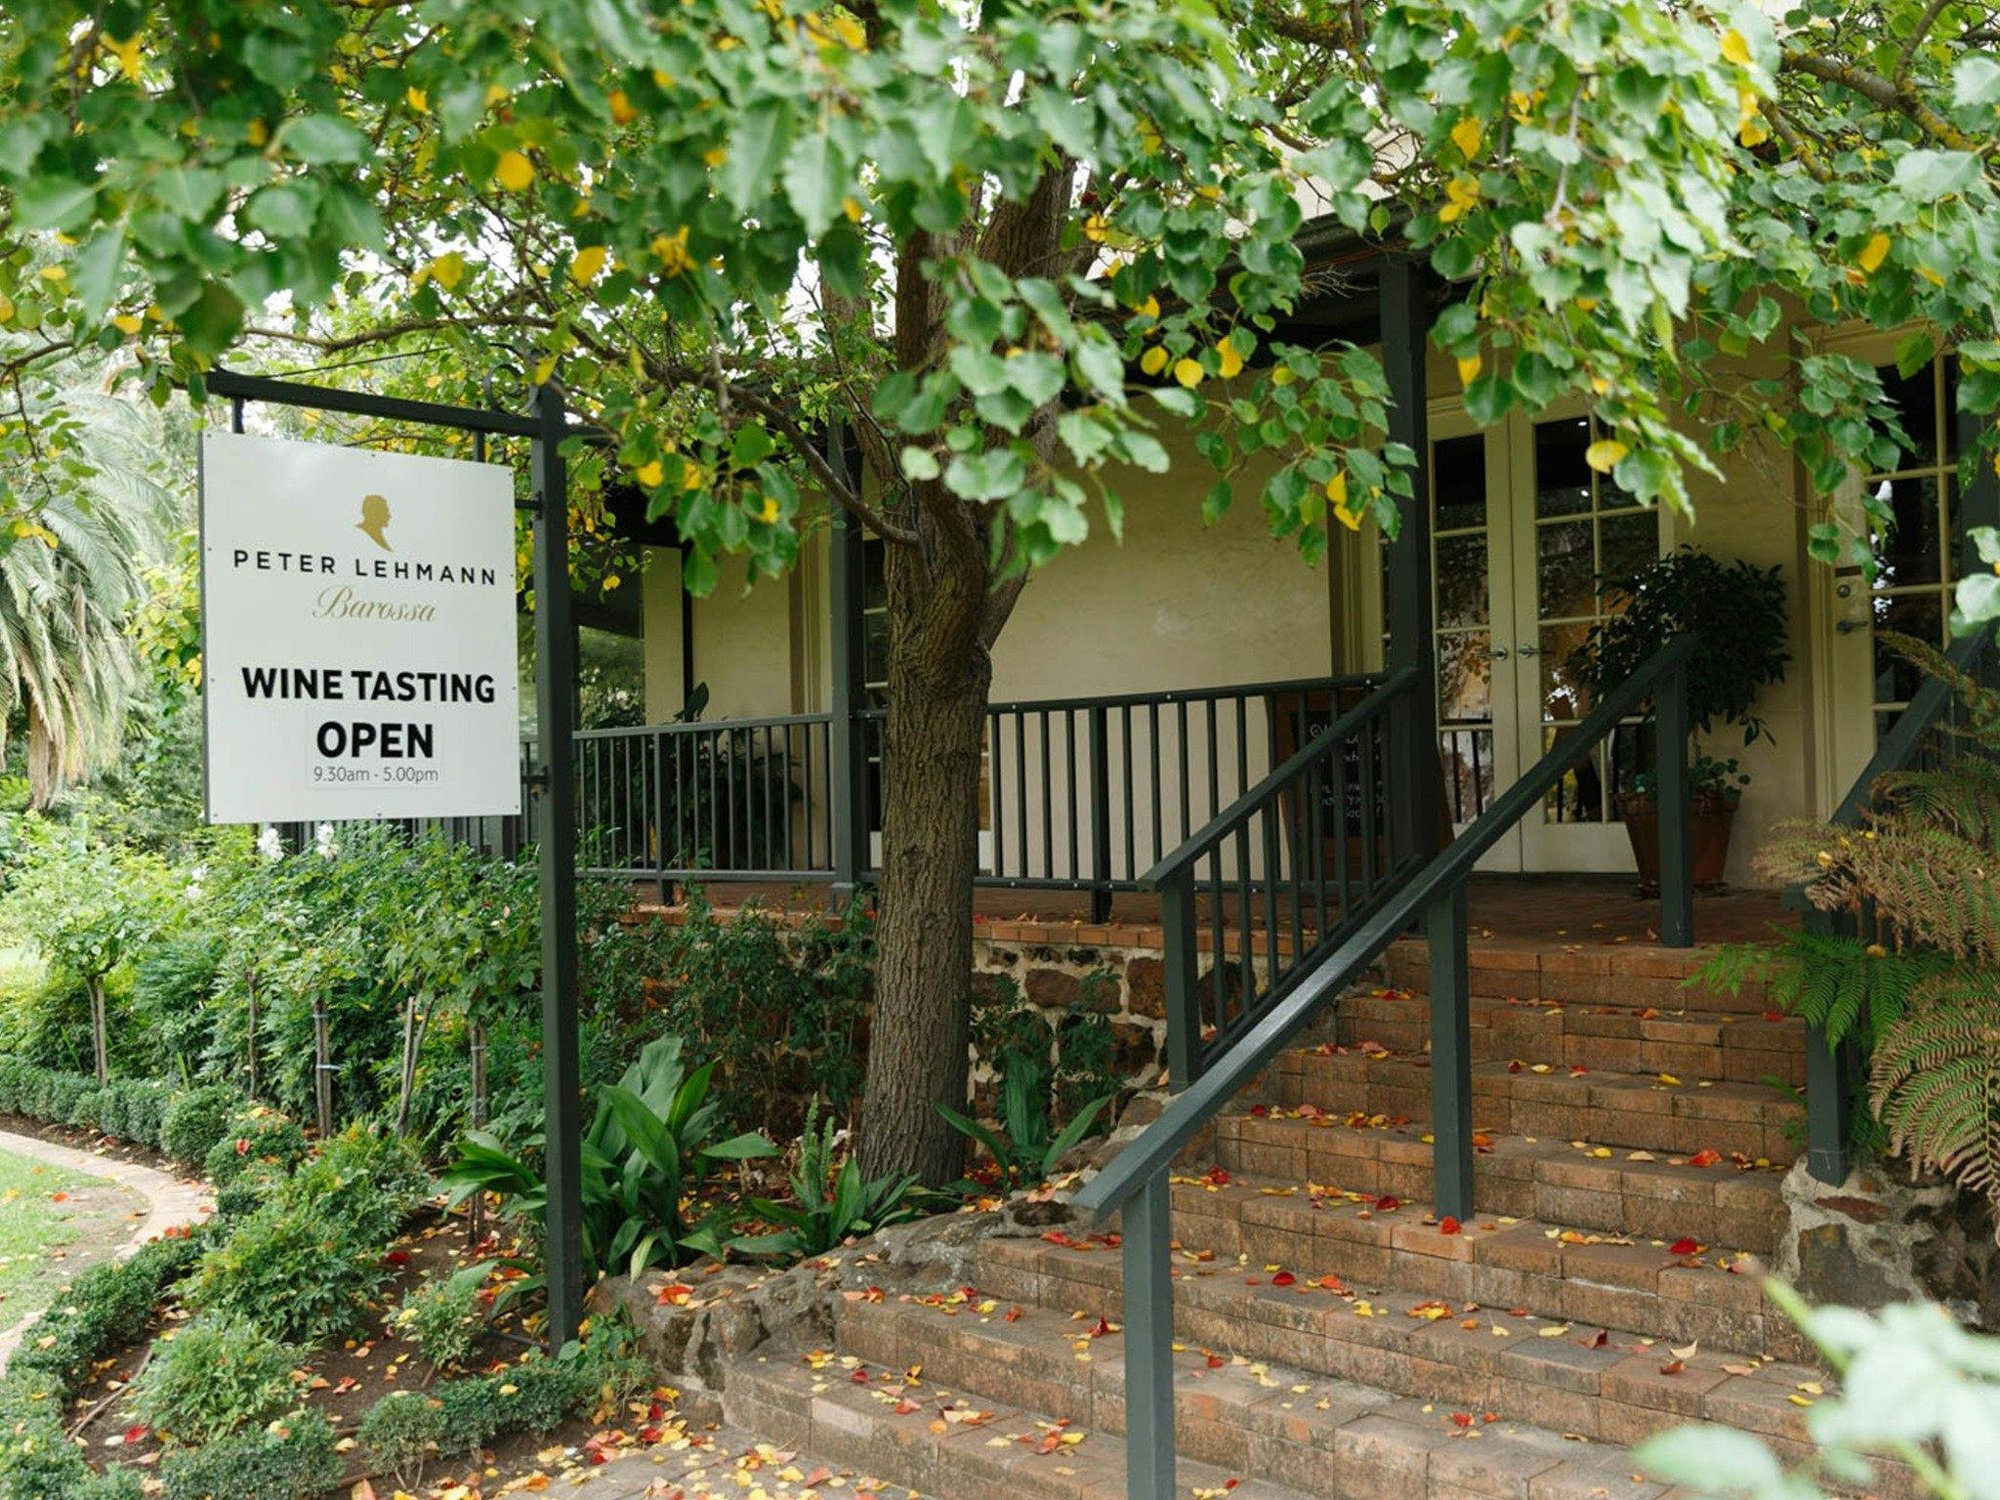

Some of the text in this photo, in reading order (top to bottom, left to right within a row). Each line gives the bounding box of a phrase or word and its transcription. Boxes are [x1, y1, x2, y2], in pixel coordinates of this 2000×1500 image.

[233, 549, 496, 586] PETER LEHMANN
[312, 585, 436, 622] Barossa
[241, 667, 495, 704] WINE TASTING
[316, 721, 434, 759] OPEN
[313, 766, 370, 782] 9.30am
[383, 766, 439, 785] 5.00pm
